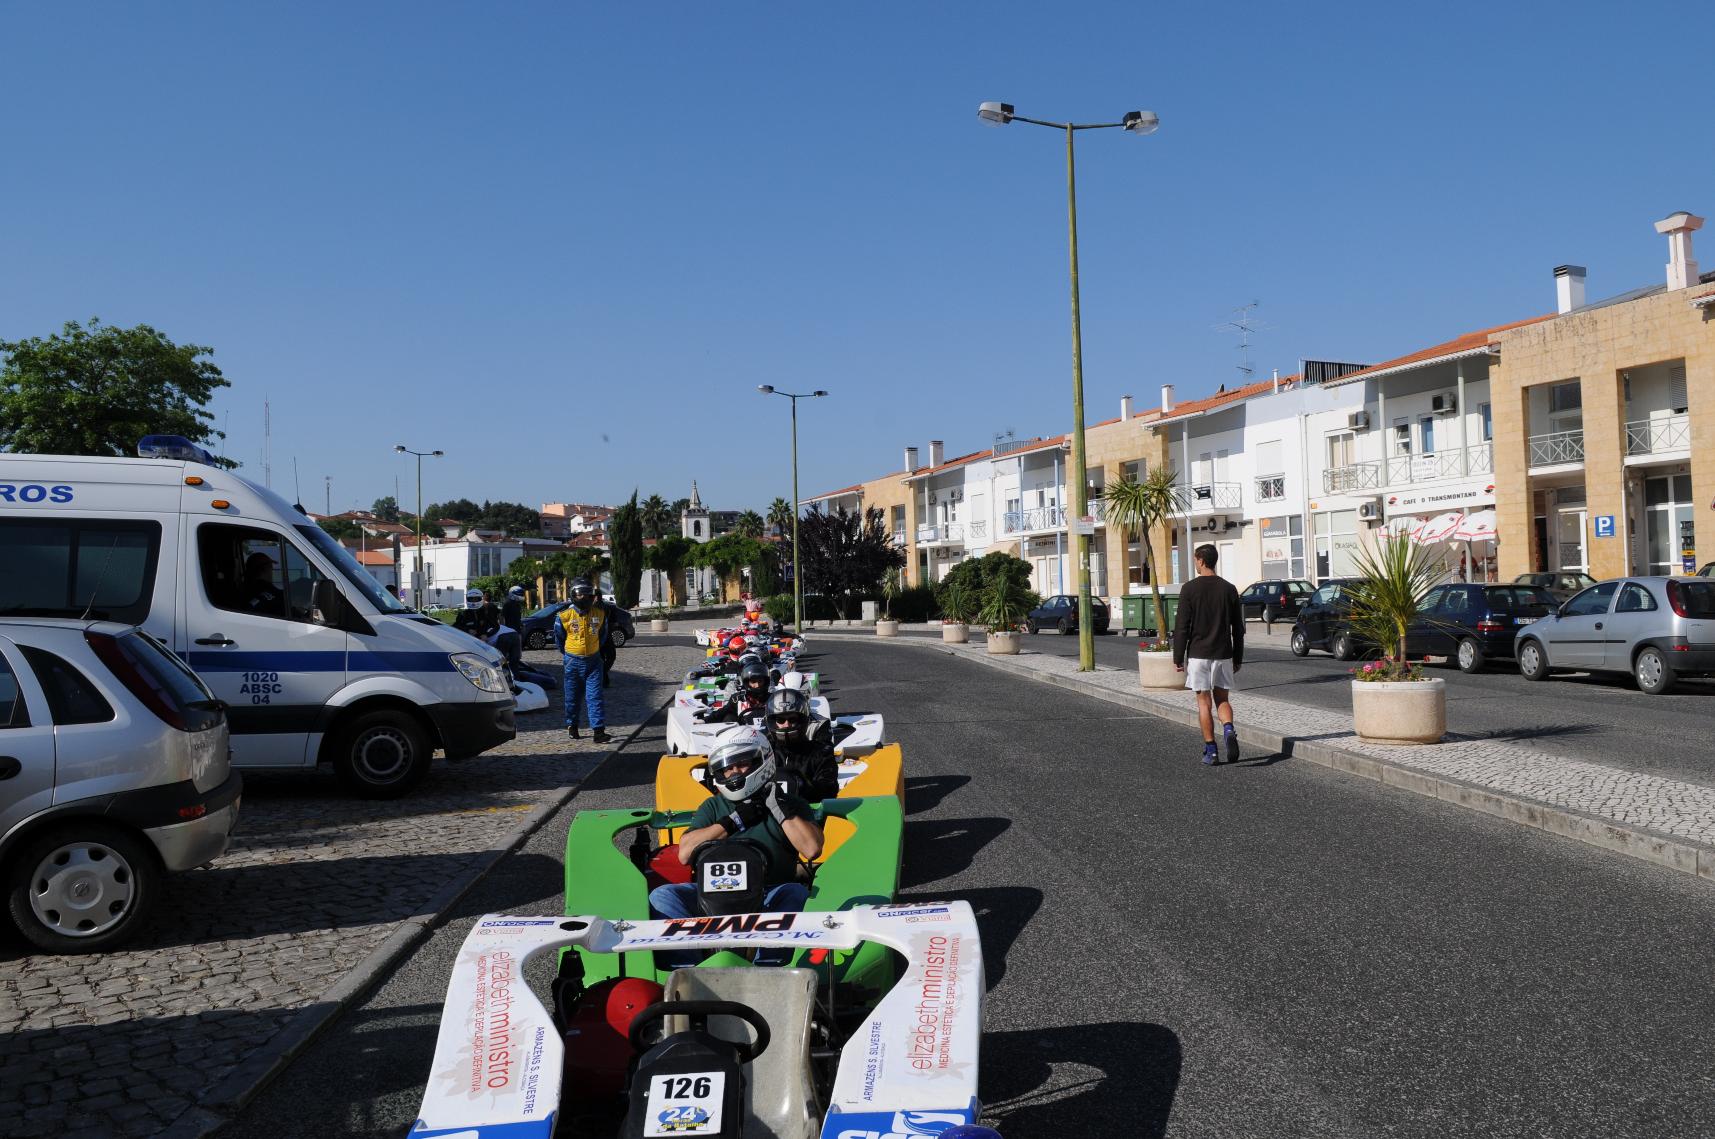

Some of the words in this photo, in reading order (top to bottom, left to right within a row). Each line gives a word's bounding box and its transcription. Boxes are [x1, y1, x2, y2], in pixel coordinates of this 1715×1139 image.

[1428, 491, 1477, 502] TRANSMONTANO
[1598, 517, 1611, 533] P
[242, 672, 279, 683] 1020
[240, 683, 282, 694] ABSC
[252, 694, 271, 705] 04
[710, 863, 742, 877] 89
[661, 913, 797, 937] PMH
[907, 936, 947, 1070] elizabethministro
[487, 951, 516, 1089] elizabethministro
[869, 1021, 882, 1056] SILVESTRE
[938, 1037, 951, 1069] MEDICINA
[523, 1074, 539, 1114] SILVESTRE
[662, 1077, 712, 1099] 126
[665, 1107, 697, 1122] 24
